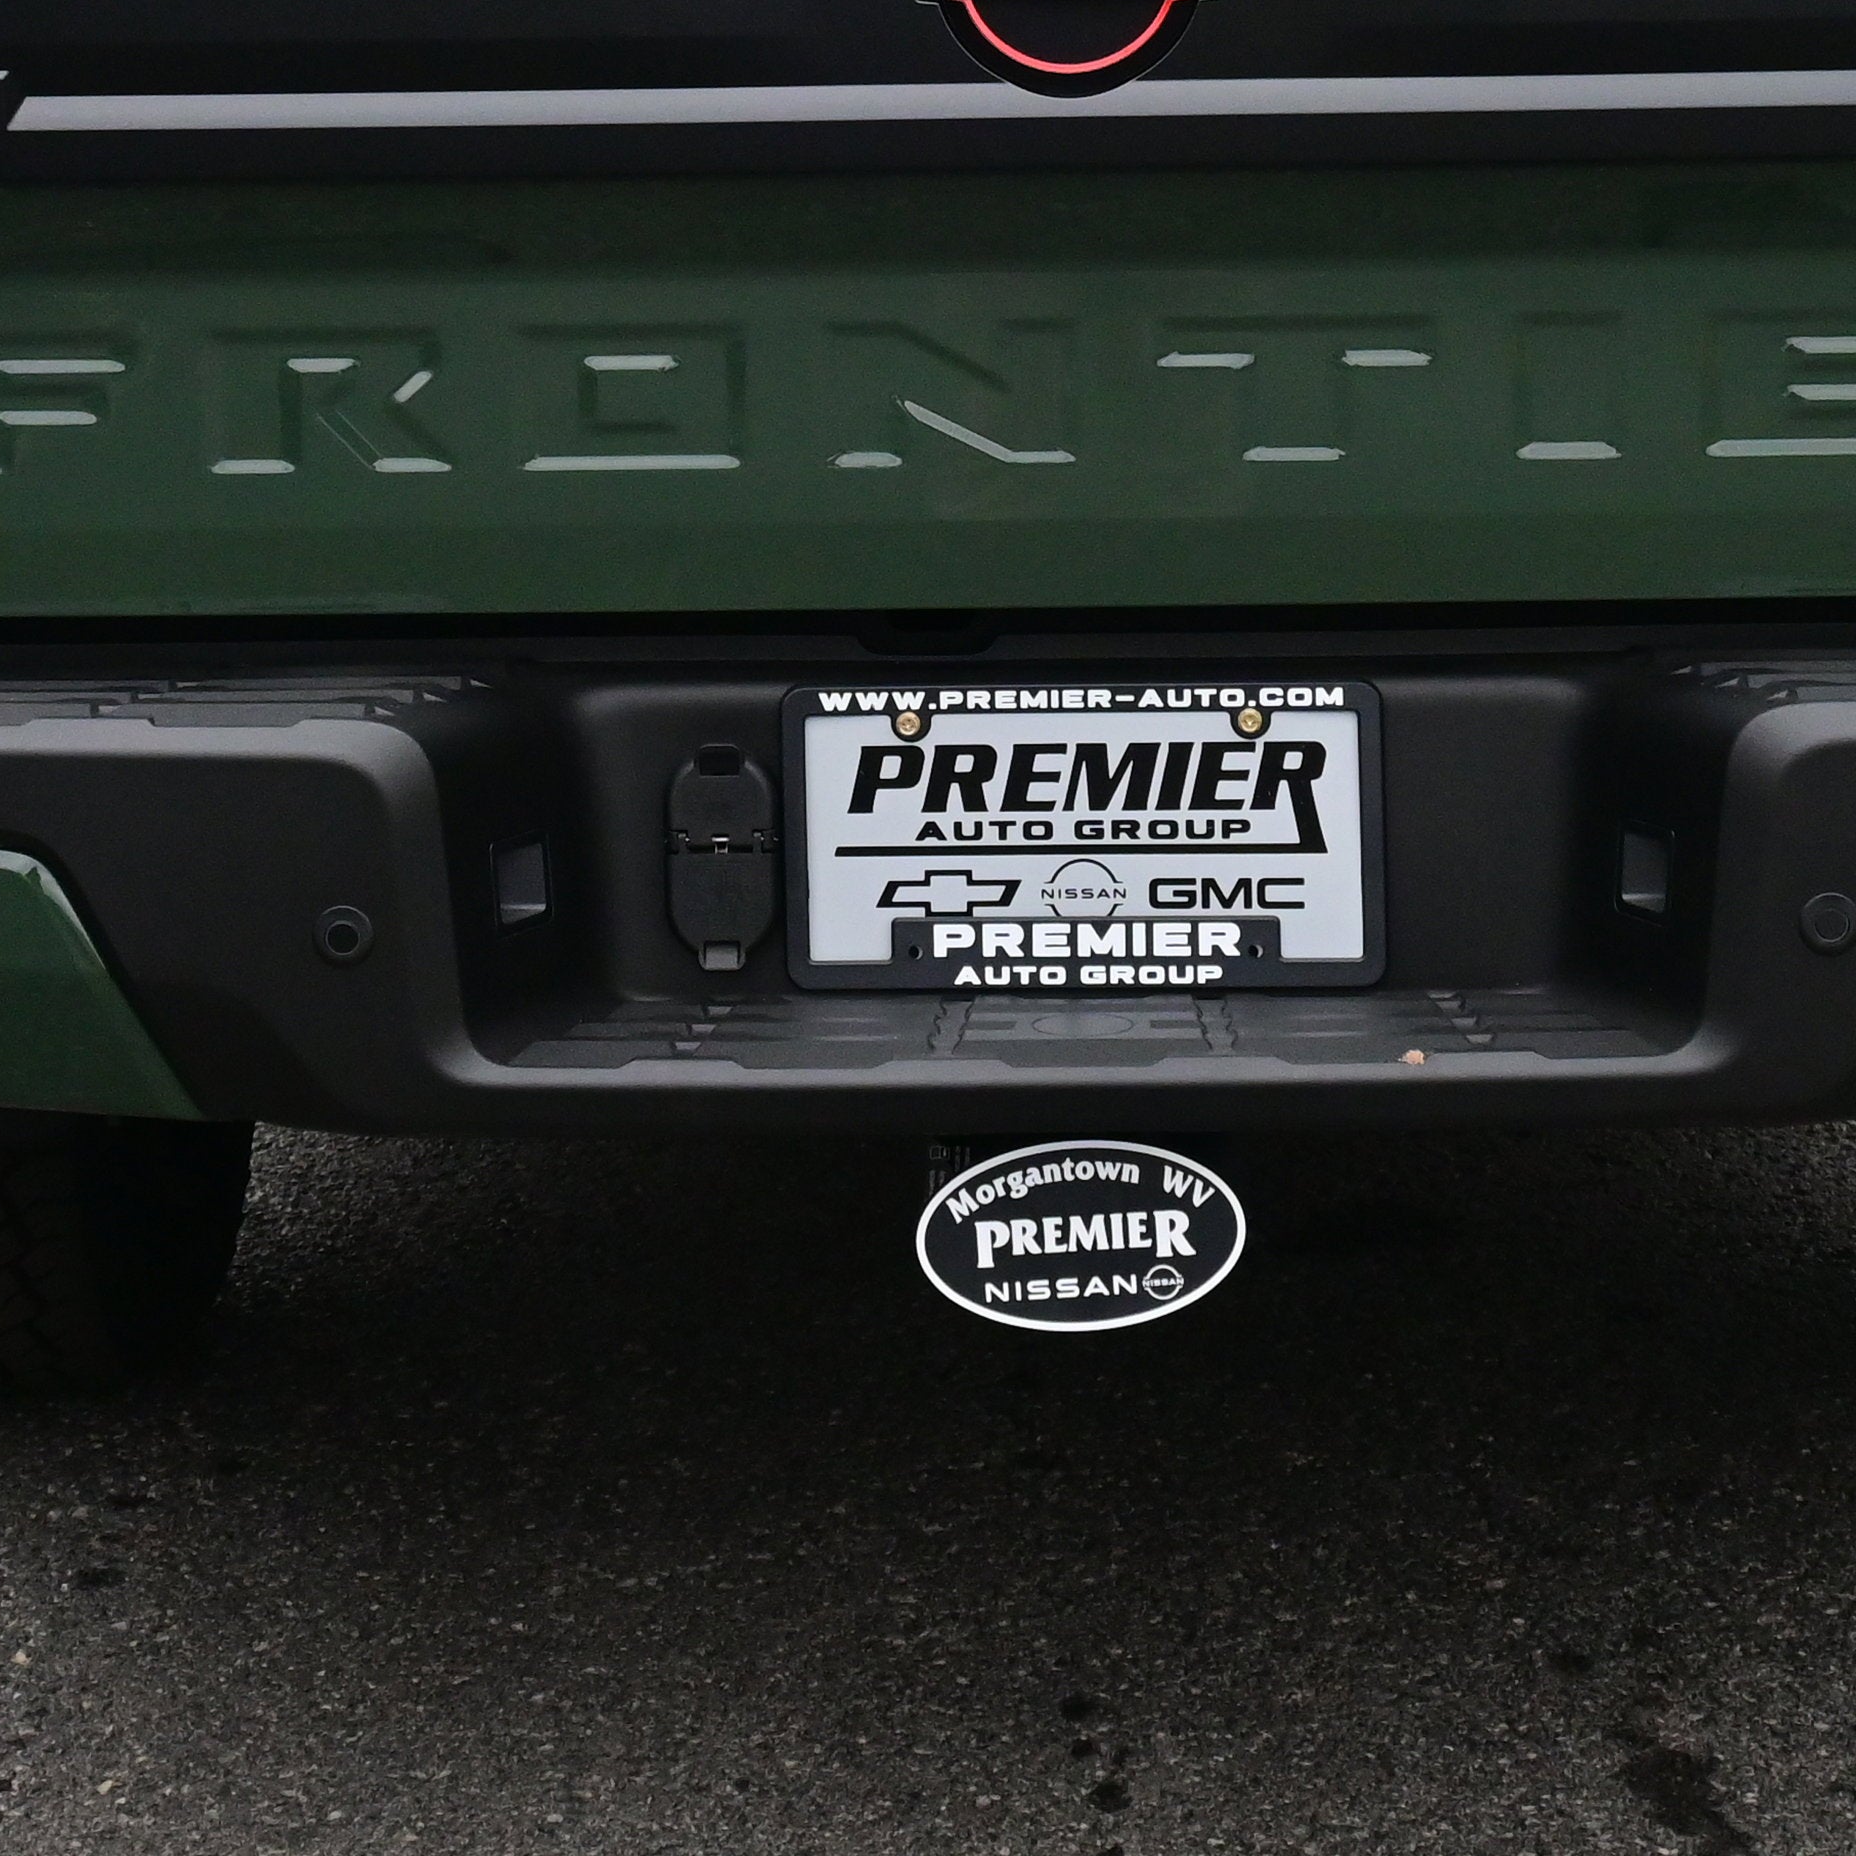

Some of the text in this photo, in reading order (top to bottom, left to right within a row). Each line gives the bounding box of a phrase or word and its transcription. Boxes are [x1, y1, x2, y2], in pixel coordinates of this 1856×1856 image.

[819, 687, 1344, 712] WWW.PREMIER-AUTO.COM
[846, 741, 1328, 853] PREMIER
[915, 818, 1252, 841] AUTO GROUP
[1041, 887, 1126, 900] NISSAN
[1148, 877, 1305, 910] GMC
[932, 922, 1242, 959] PREMIER
[954, 964, 1224, 986] AUTO GROUP
[945, 1157, 1215, 1224] Morgantown WV
[974, 1209, 1196, 1269] PREMIER
[984, 1274, 1138, 1303] NISSAN
[1143, 1276, 1184, 1287] NISSAN
